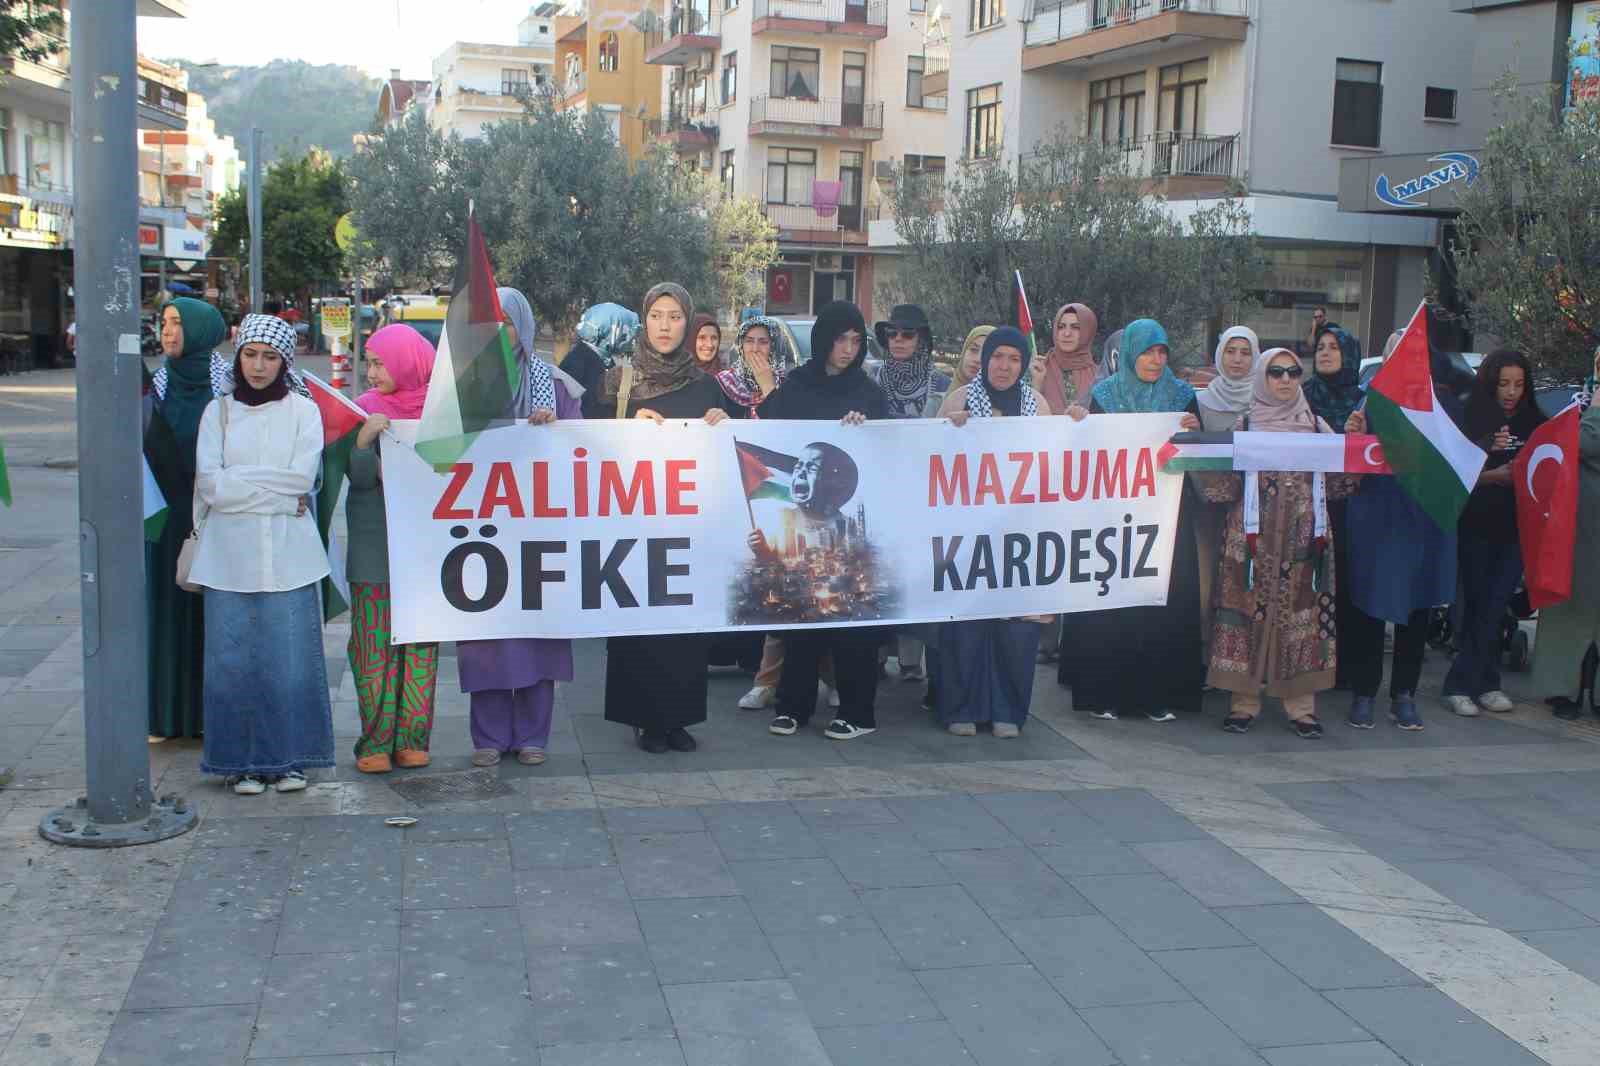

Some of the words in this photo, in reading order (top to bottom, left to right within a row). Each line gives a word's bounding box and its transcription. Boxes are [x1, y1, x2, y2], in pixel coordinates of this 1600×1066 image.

[432, 447, 699, 520] ZALİME
[927, 447, 1157, 508] MAZLUMA
[440, 523, 694, 613] ÖFKE
[931, 513, 1160, 597] KARDEŞİZ
